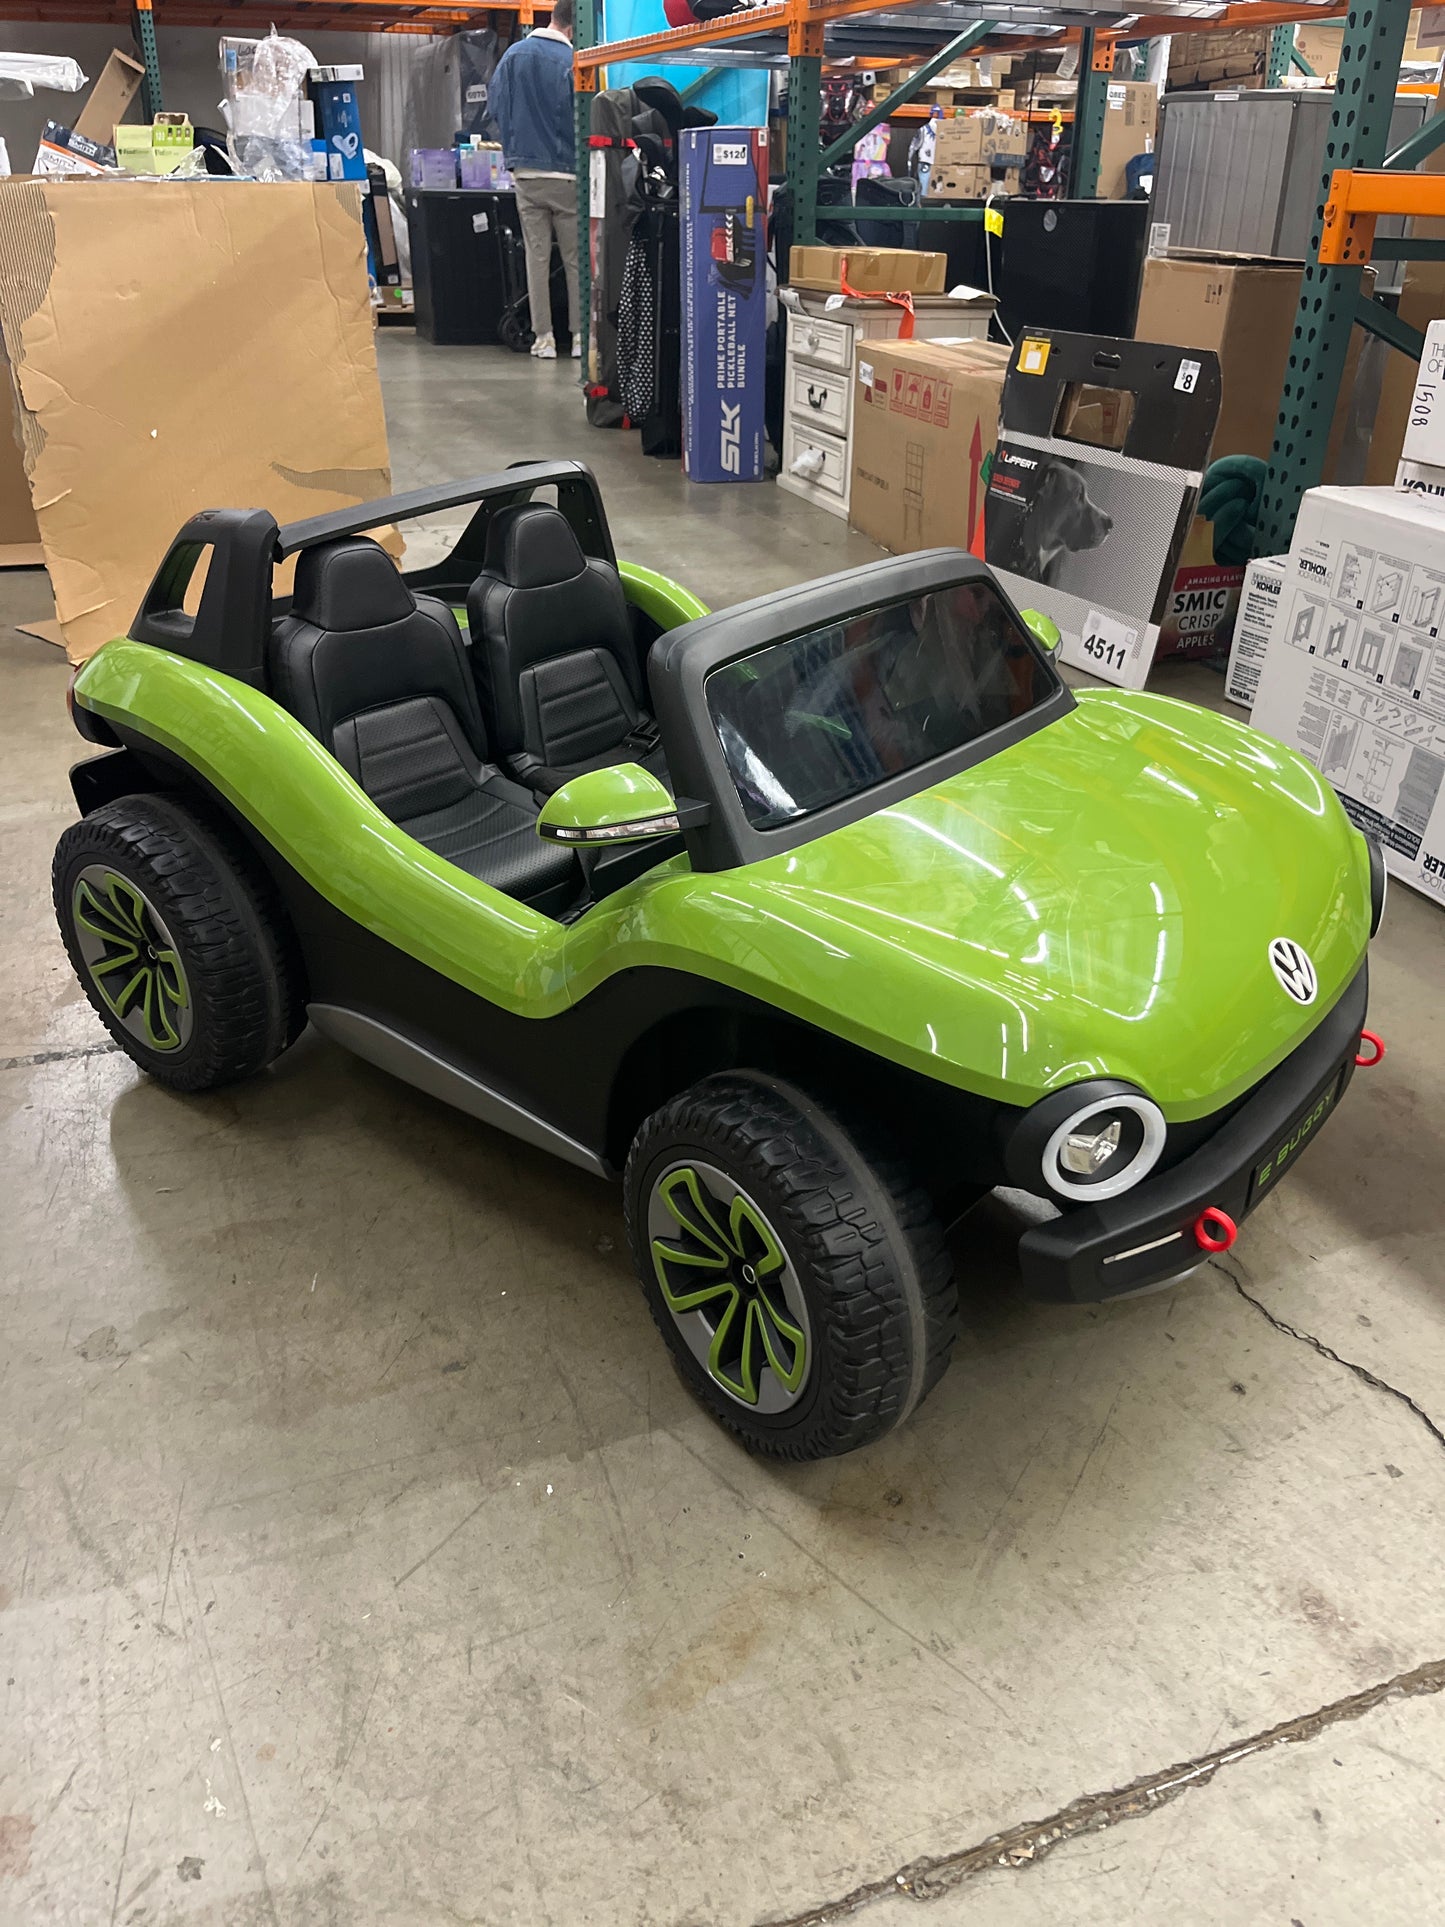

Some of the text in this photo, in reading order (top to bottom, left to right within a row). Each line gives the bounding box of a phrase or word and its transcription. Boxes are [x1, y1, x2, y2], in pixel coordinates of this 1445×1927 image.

[717, 291, 726, 389] PRIME PORTABLE
[727, 295, 736, 389] PICKLEBALL NET
[737, 344, 746, 389] BUNDLE
[1411, 383, 1437, 426] 1508
[721, 400, 741, 475] SLK
[1004, 454, 1038, 470] LIPPERT
[1188, 575, 1221, 585] AMAZING
[1299, 559, 1327, 577] KOHLER
[1173, 590, 1226, 613] SMIC
[1178, 613, 1219, 631] CRISP
[1084, 634, 1126, 670] 4511
[1176, 634, 1215, 649] APPLES
[1258, 1087, 1335, 1187] E BUGGY
